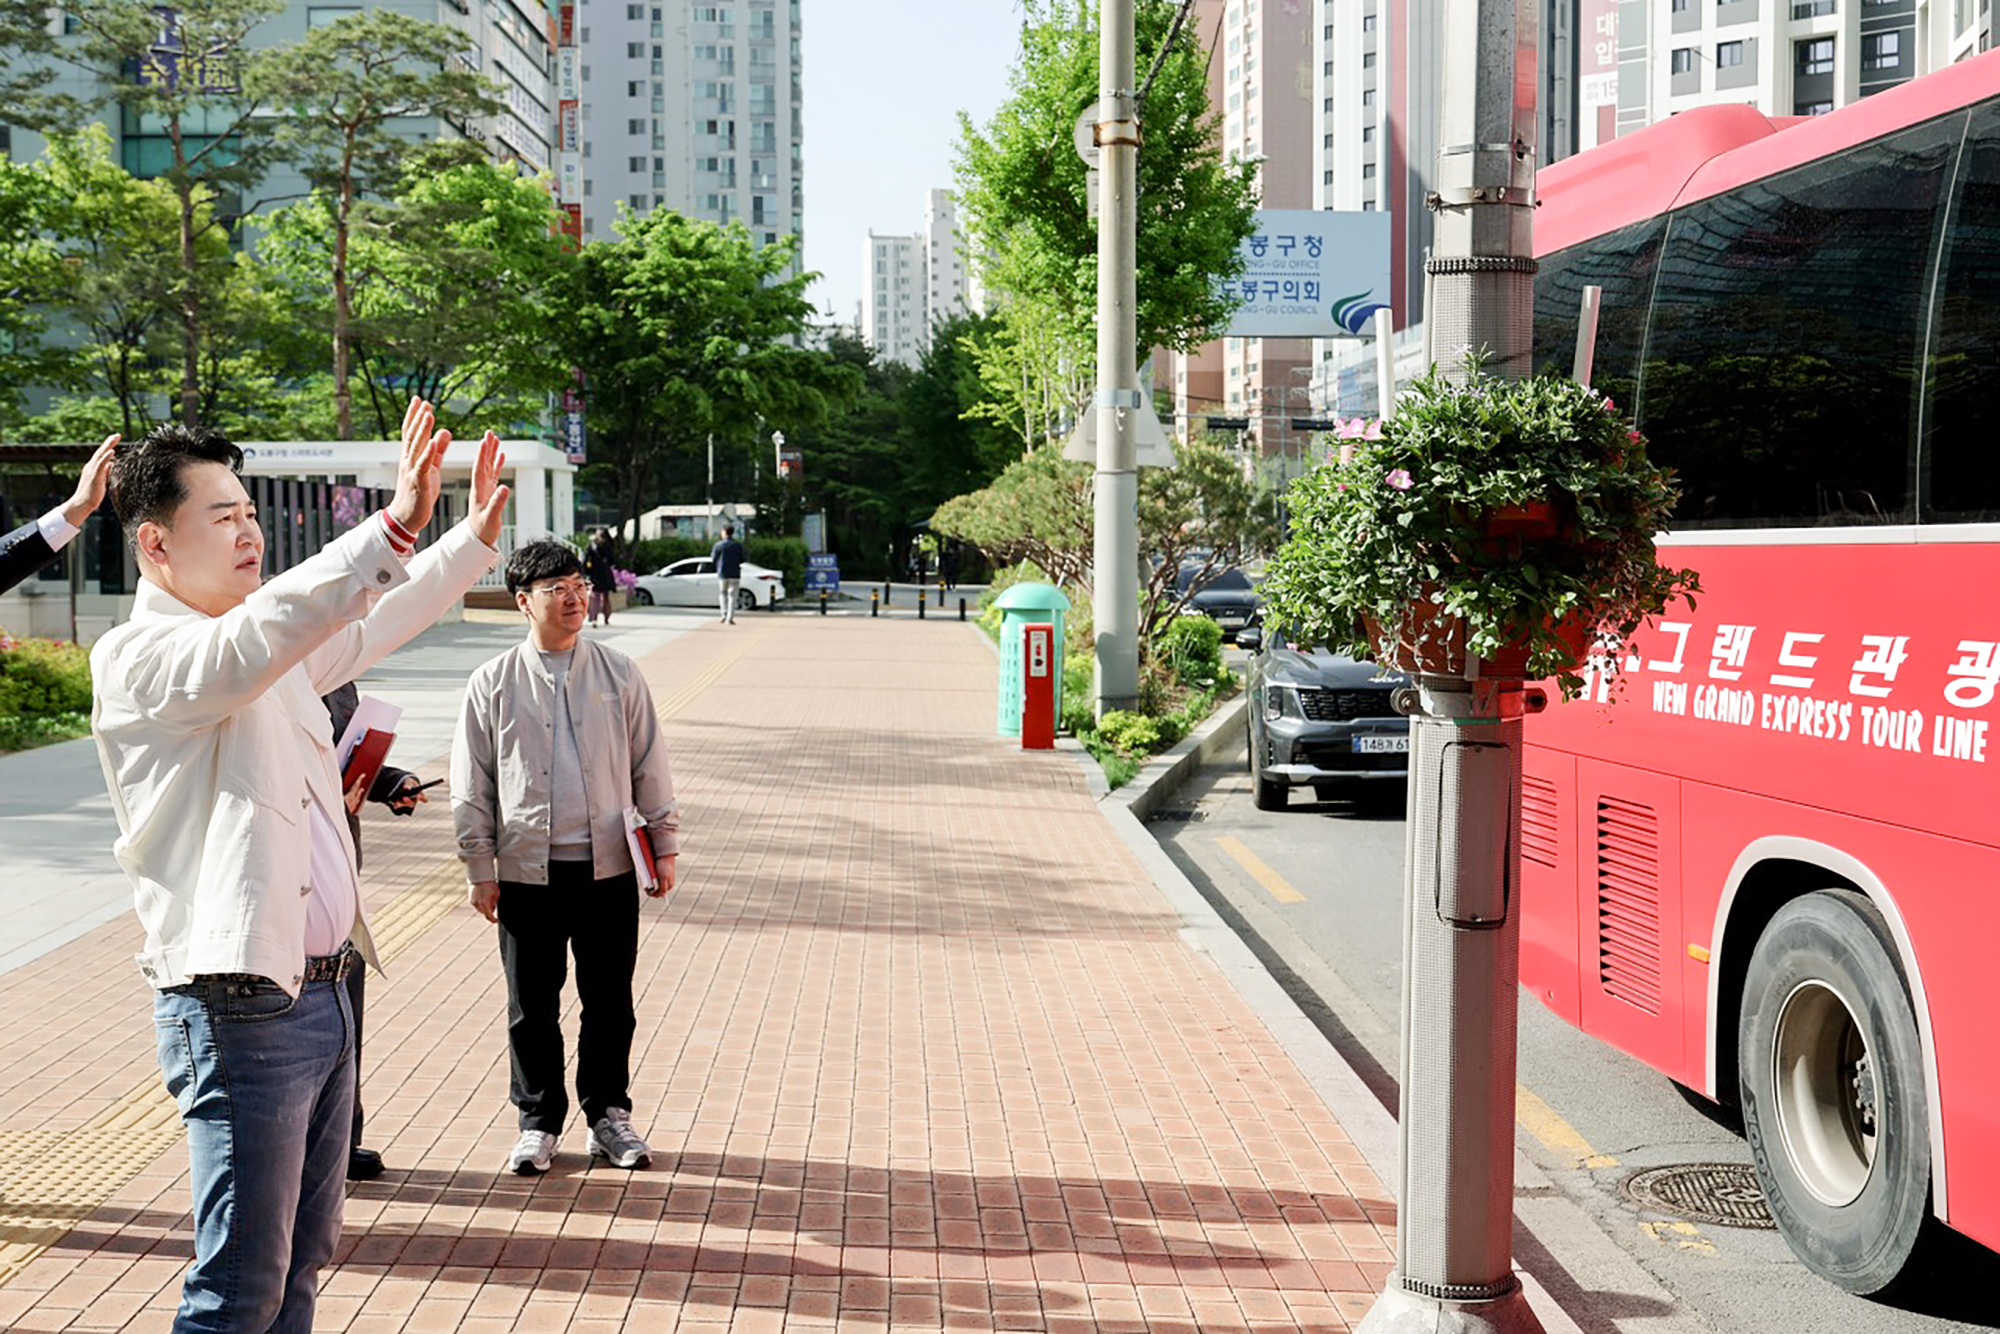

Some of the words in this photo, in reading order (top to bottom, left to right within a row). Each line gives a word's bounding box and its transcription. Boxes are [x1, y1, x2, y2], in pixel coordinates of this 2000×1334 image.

[1596, 11, 1619, 37] 대
[1595, 39, 1619, 66] 입
[1249, 235, 1322, 258] 봉구청
[1288, 260, 1320, 270] OFFICE
[1222, 280, 1320, 303] 도봉구의회
[1238, 305, 1278, 315] ONG-GU
[1280, 305, 1318, 315] COUNCIL
[1653, 681, 1688, 716] NEW
[1693, 685, 1755, 726] GRAND
[1761, 693, 1853, 741] EXPRESS
[1861, 705, 1923, 753] TOUR
[1933, 715, 1988, 763] LINE
